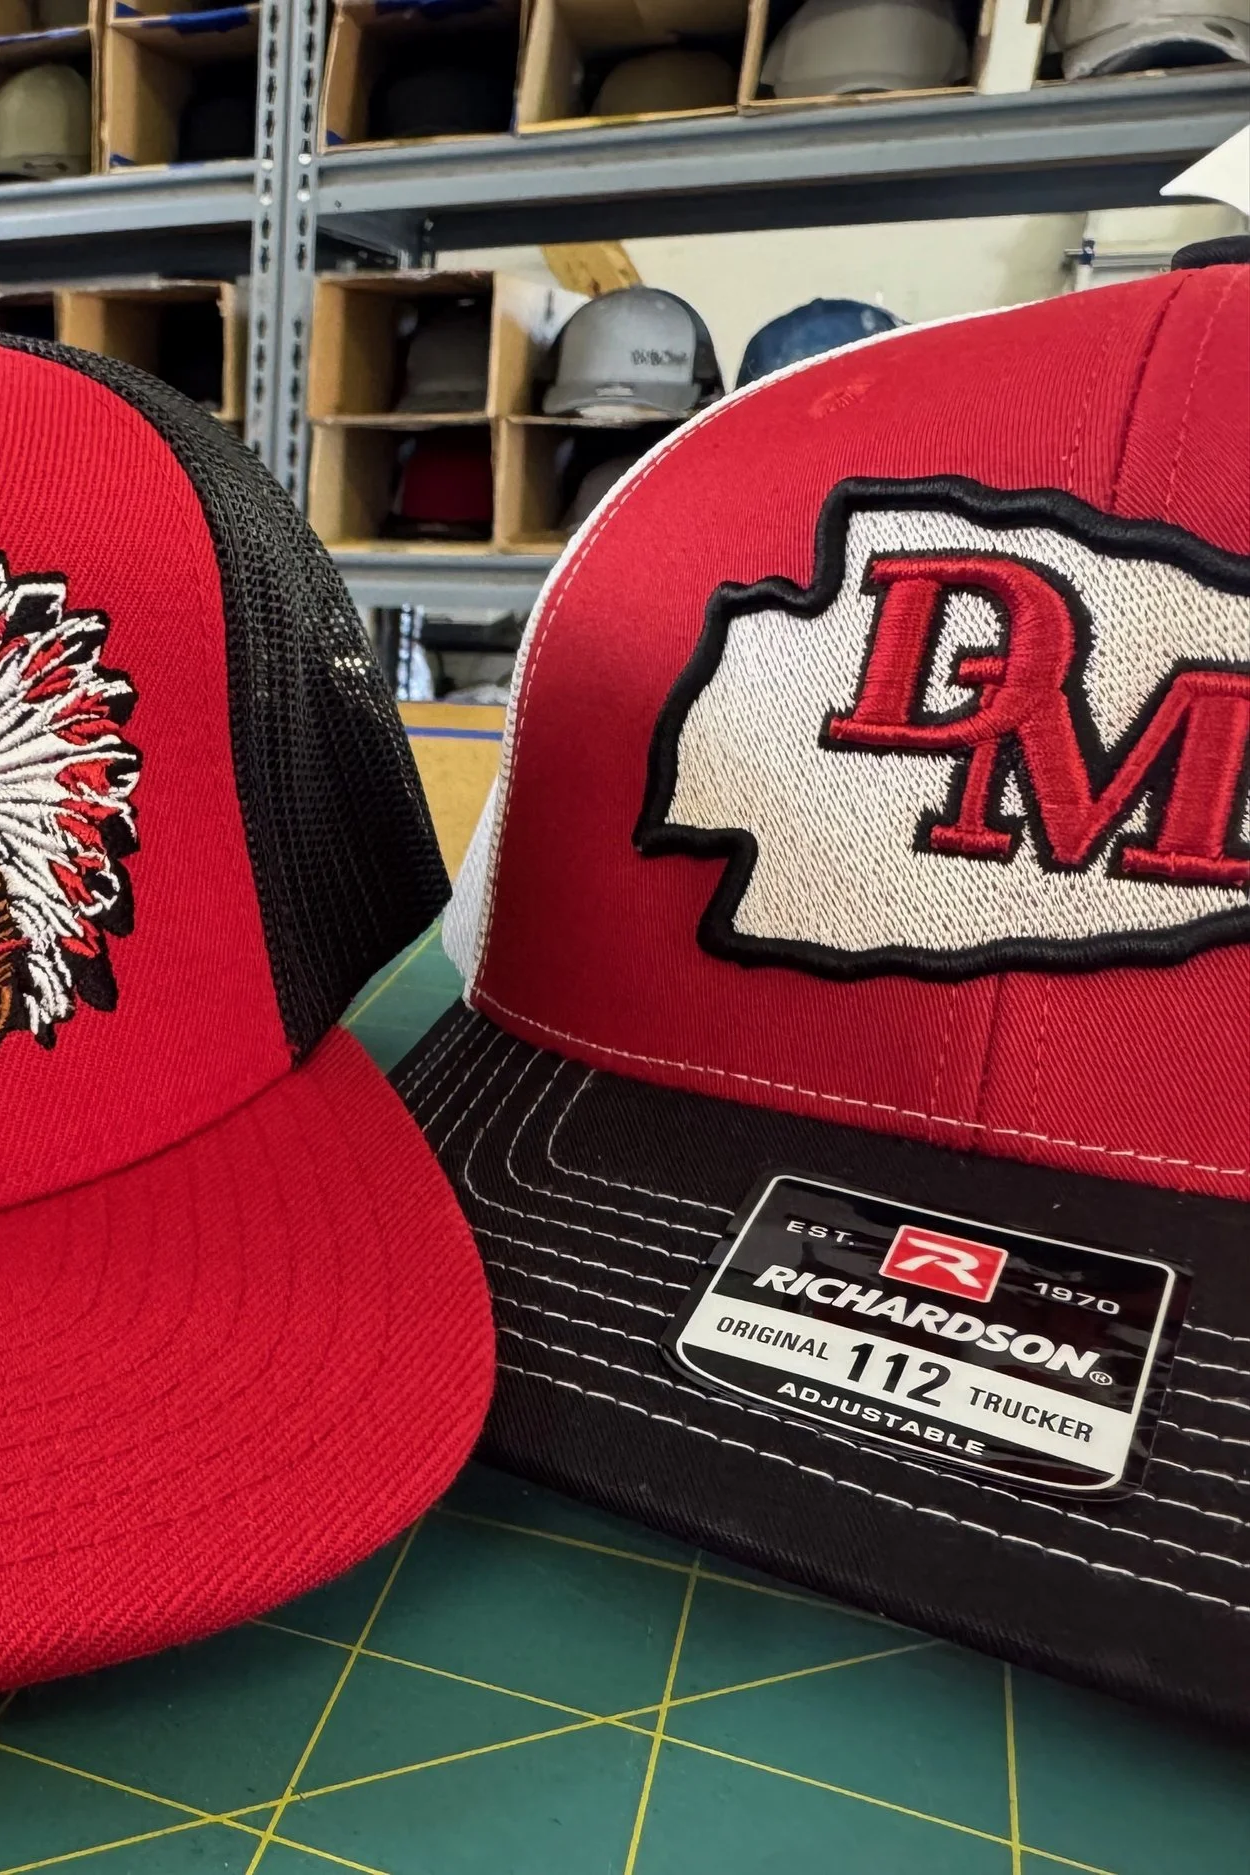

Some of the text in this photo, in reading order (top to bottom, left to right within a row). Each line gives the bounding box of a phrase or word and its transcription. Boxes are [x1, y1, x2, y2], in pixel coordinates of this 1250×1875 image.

[786, 1220, 1121, 1316] EST. 1970
[715, 1315, 1094, 1443] ORIGINAL 112 TRUCKER
[776, 1381, 986, 1457] ADJUSTABLE
